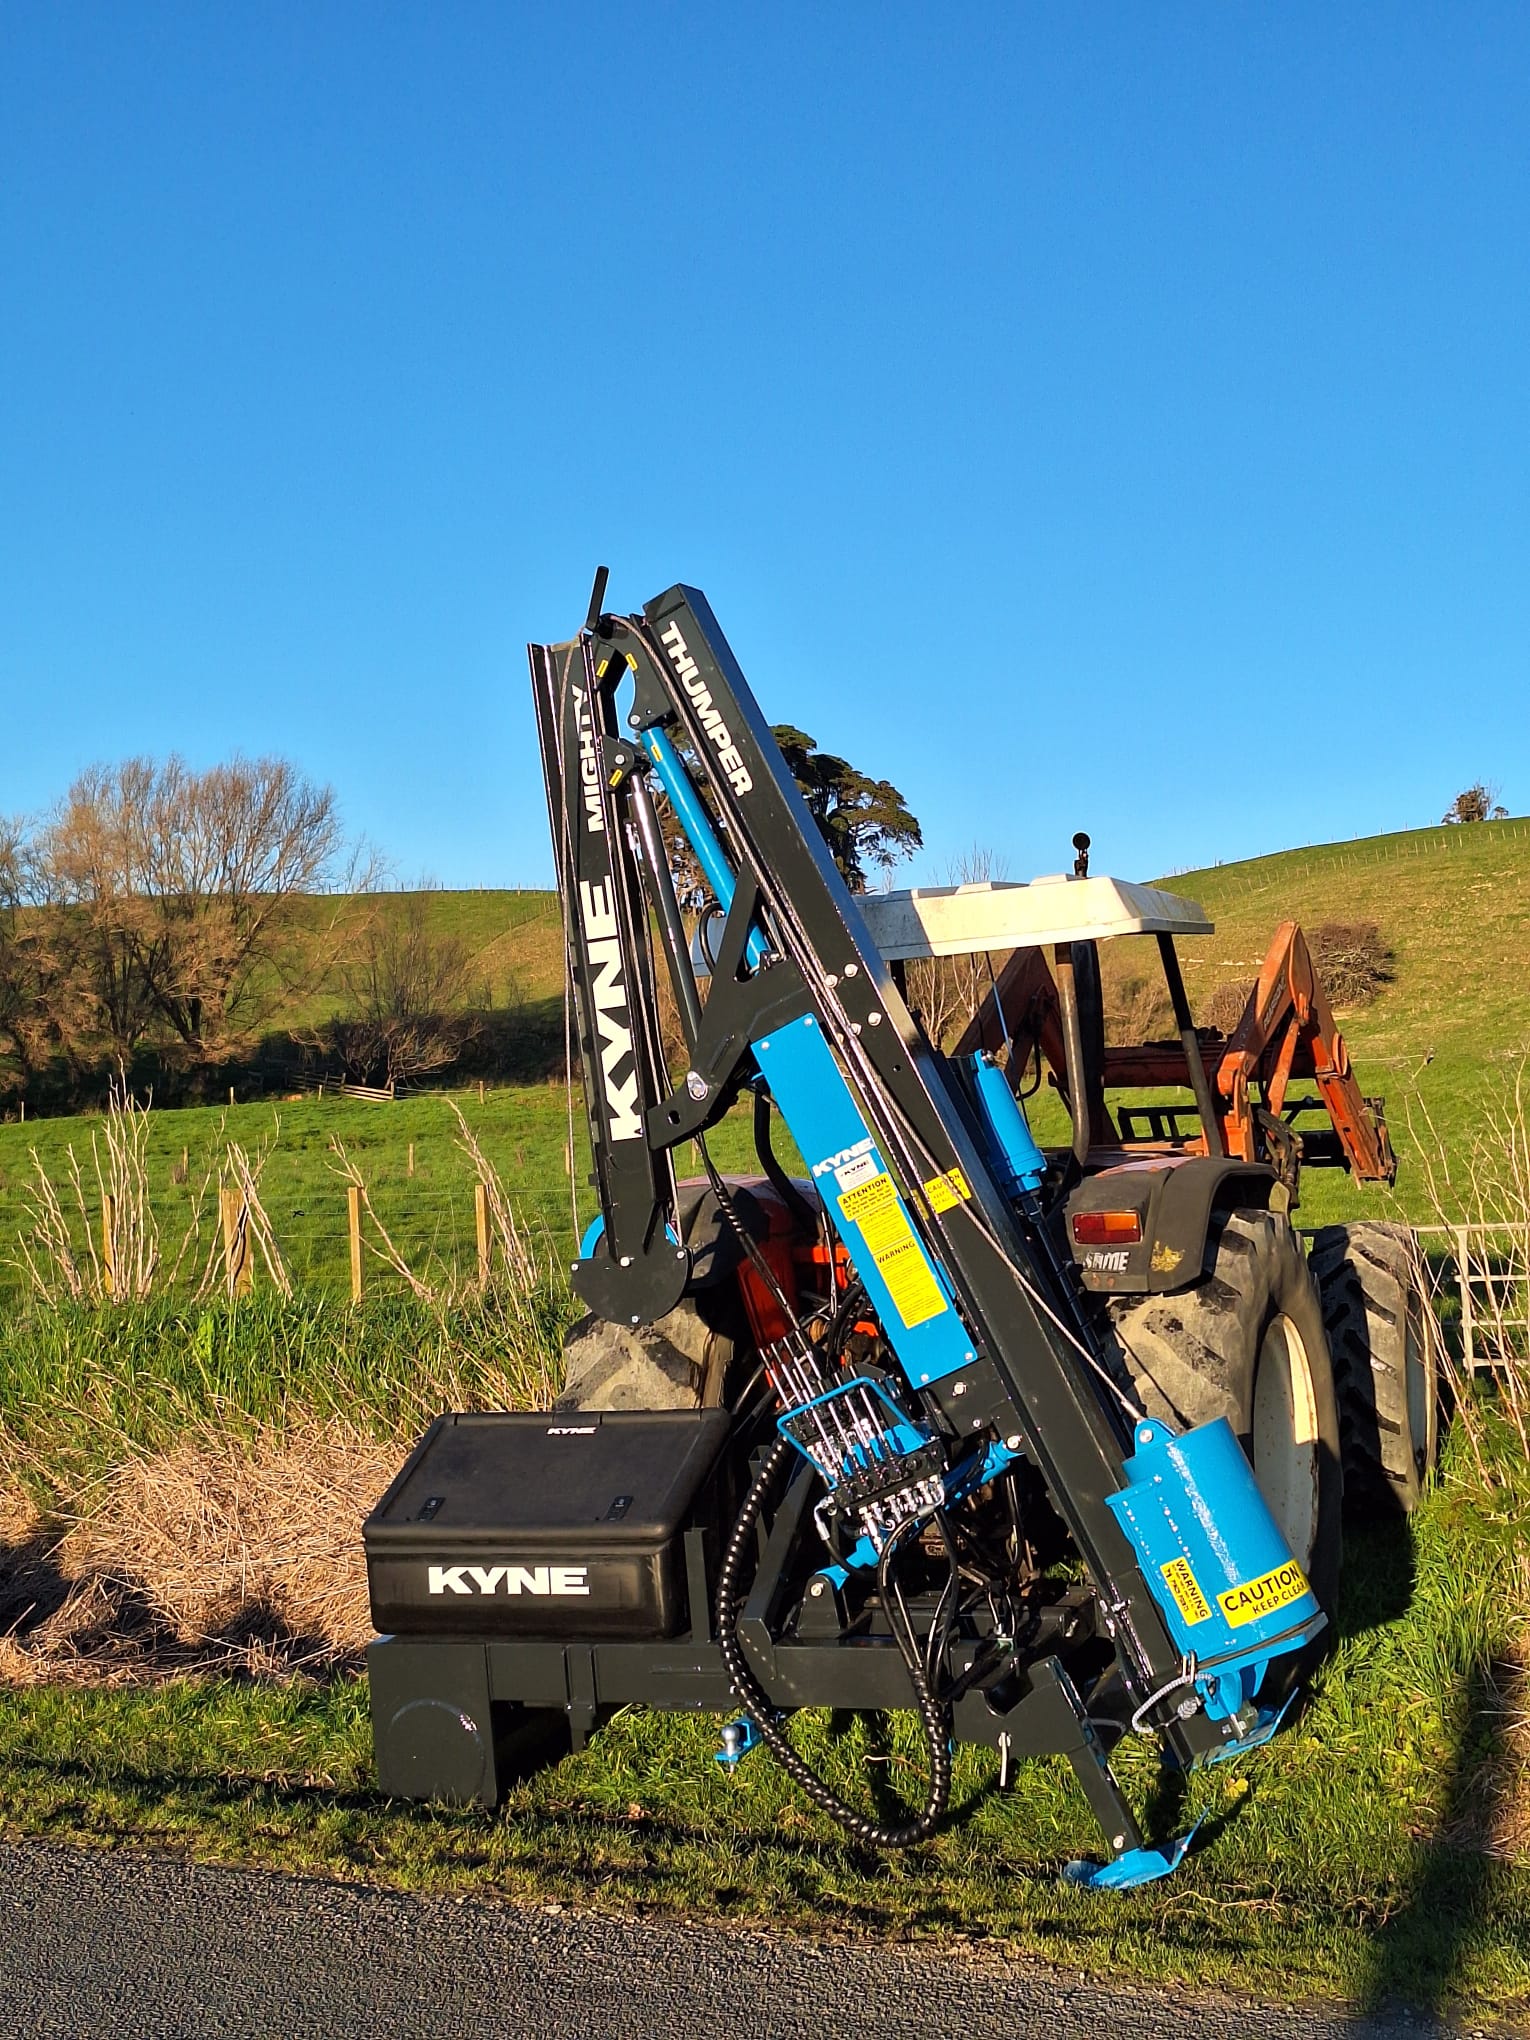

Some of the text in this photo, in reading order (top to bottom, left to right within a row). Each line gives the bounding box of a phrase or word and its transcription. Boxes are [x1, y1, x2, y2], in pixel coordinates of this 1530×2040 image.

[661, 620, 753, 797] THUMPER
[571, 683, 605, 833] MIGHTY
[579, 874, 643, 1141] KYNE
[811, 1137, 876, 1178] KYNE
[842, 1177, 888, 1205] ATTENTION
[927, 1173, 961, 1194] CAUON
[877, 1241, 916, 1265] WARNING
[546, 1426, 597, 1435] KYNE
[427, 1566, 591, 1596] KYNE
[1176, 1559, 1208, 1618] WARNING
[1223, 1565, 1300, 1612] CAUTION
[1252, 1595, 1280, 1615] KEEP
